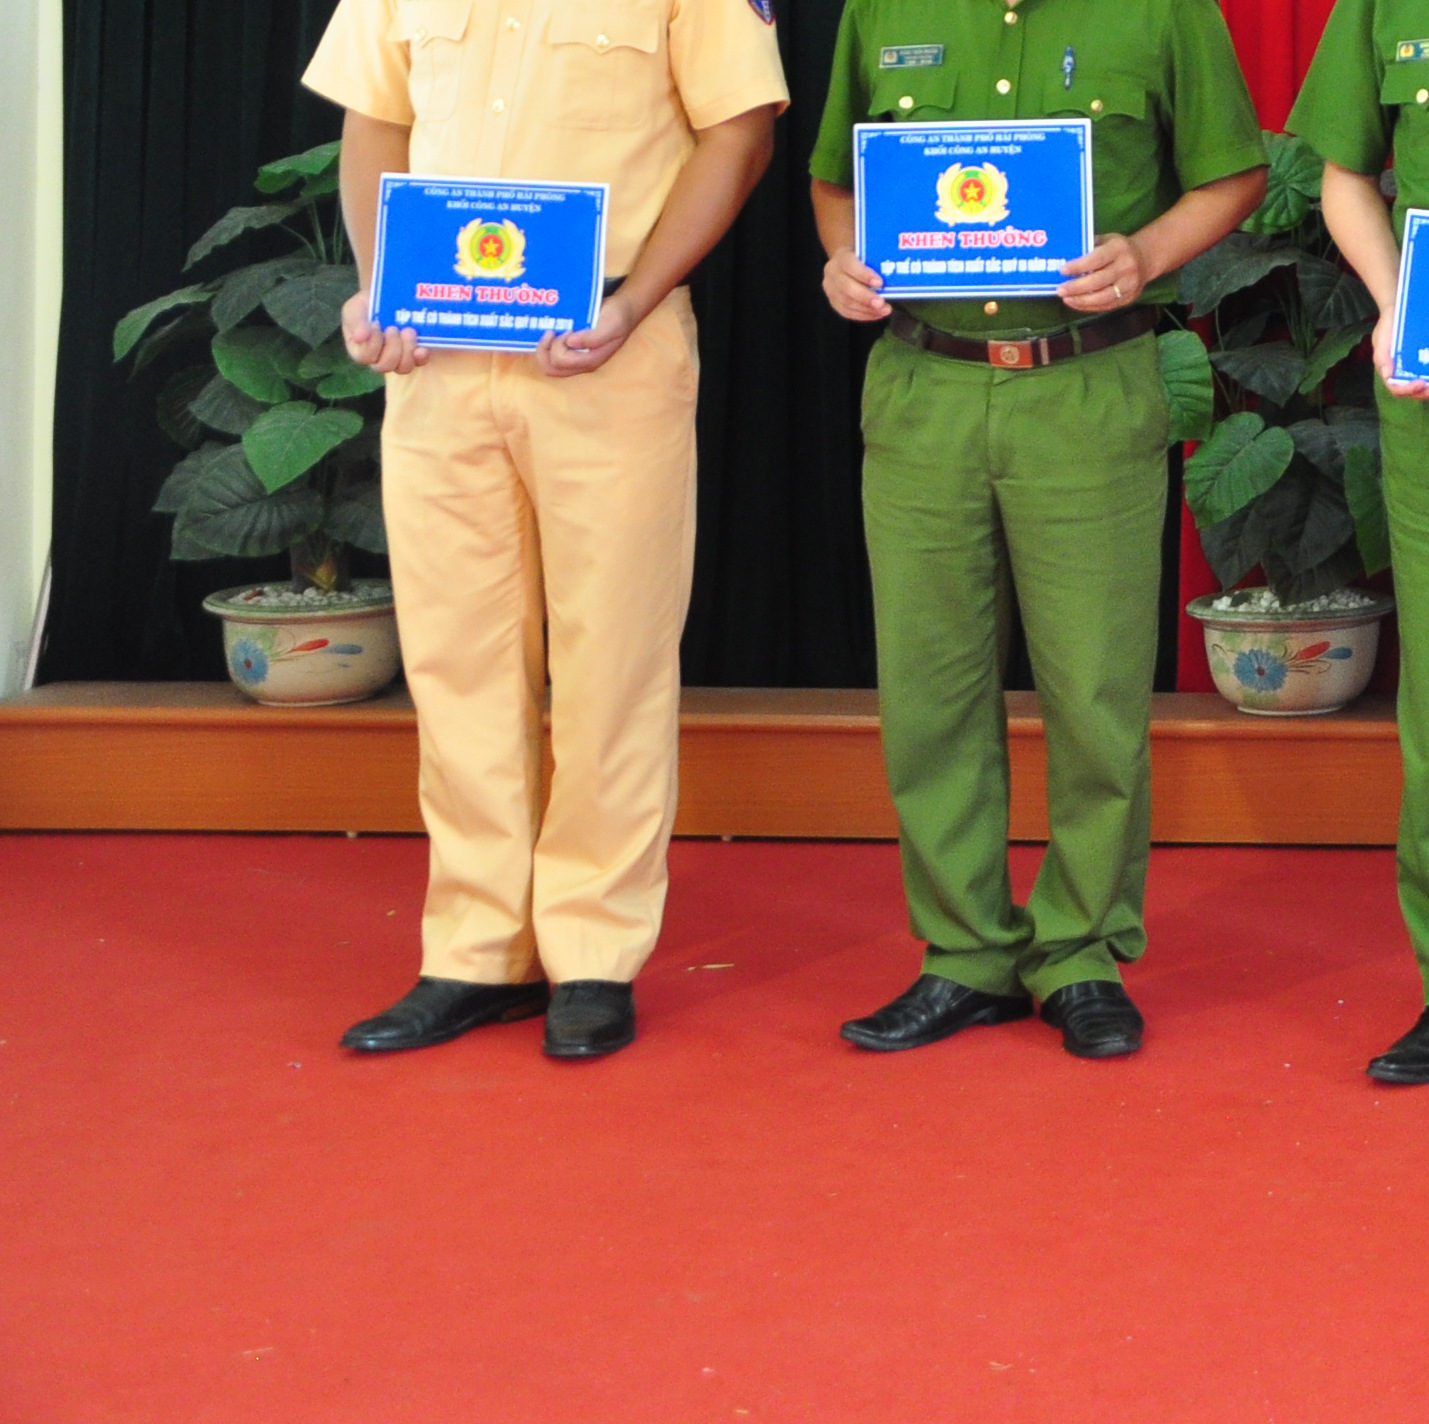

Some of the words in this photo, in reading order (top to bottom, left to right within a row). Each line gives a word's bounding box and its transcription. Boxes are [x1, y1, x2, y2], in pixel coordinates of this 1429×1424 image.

[899, 231, 956, 249] KHEN
[959, 226, 1048, 247] THƯỞNG
[416, 283, 473, 300] KHEN
[476, 283, 559, 305] THƯỞNG
